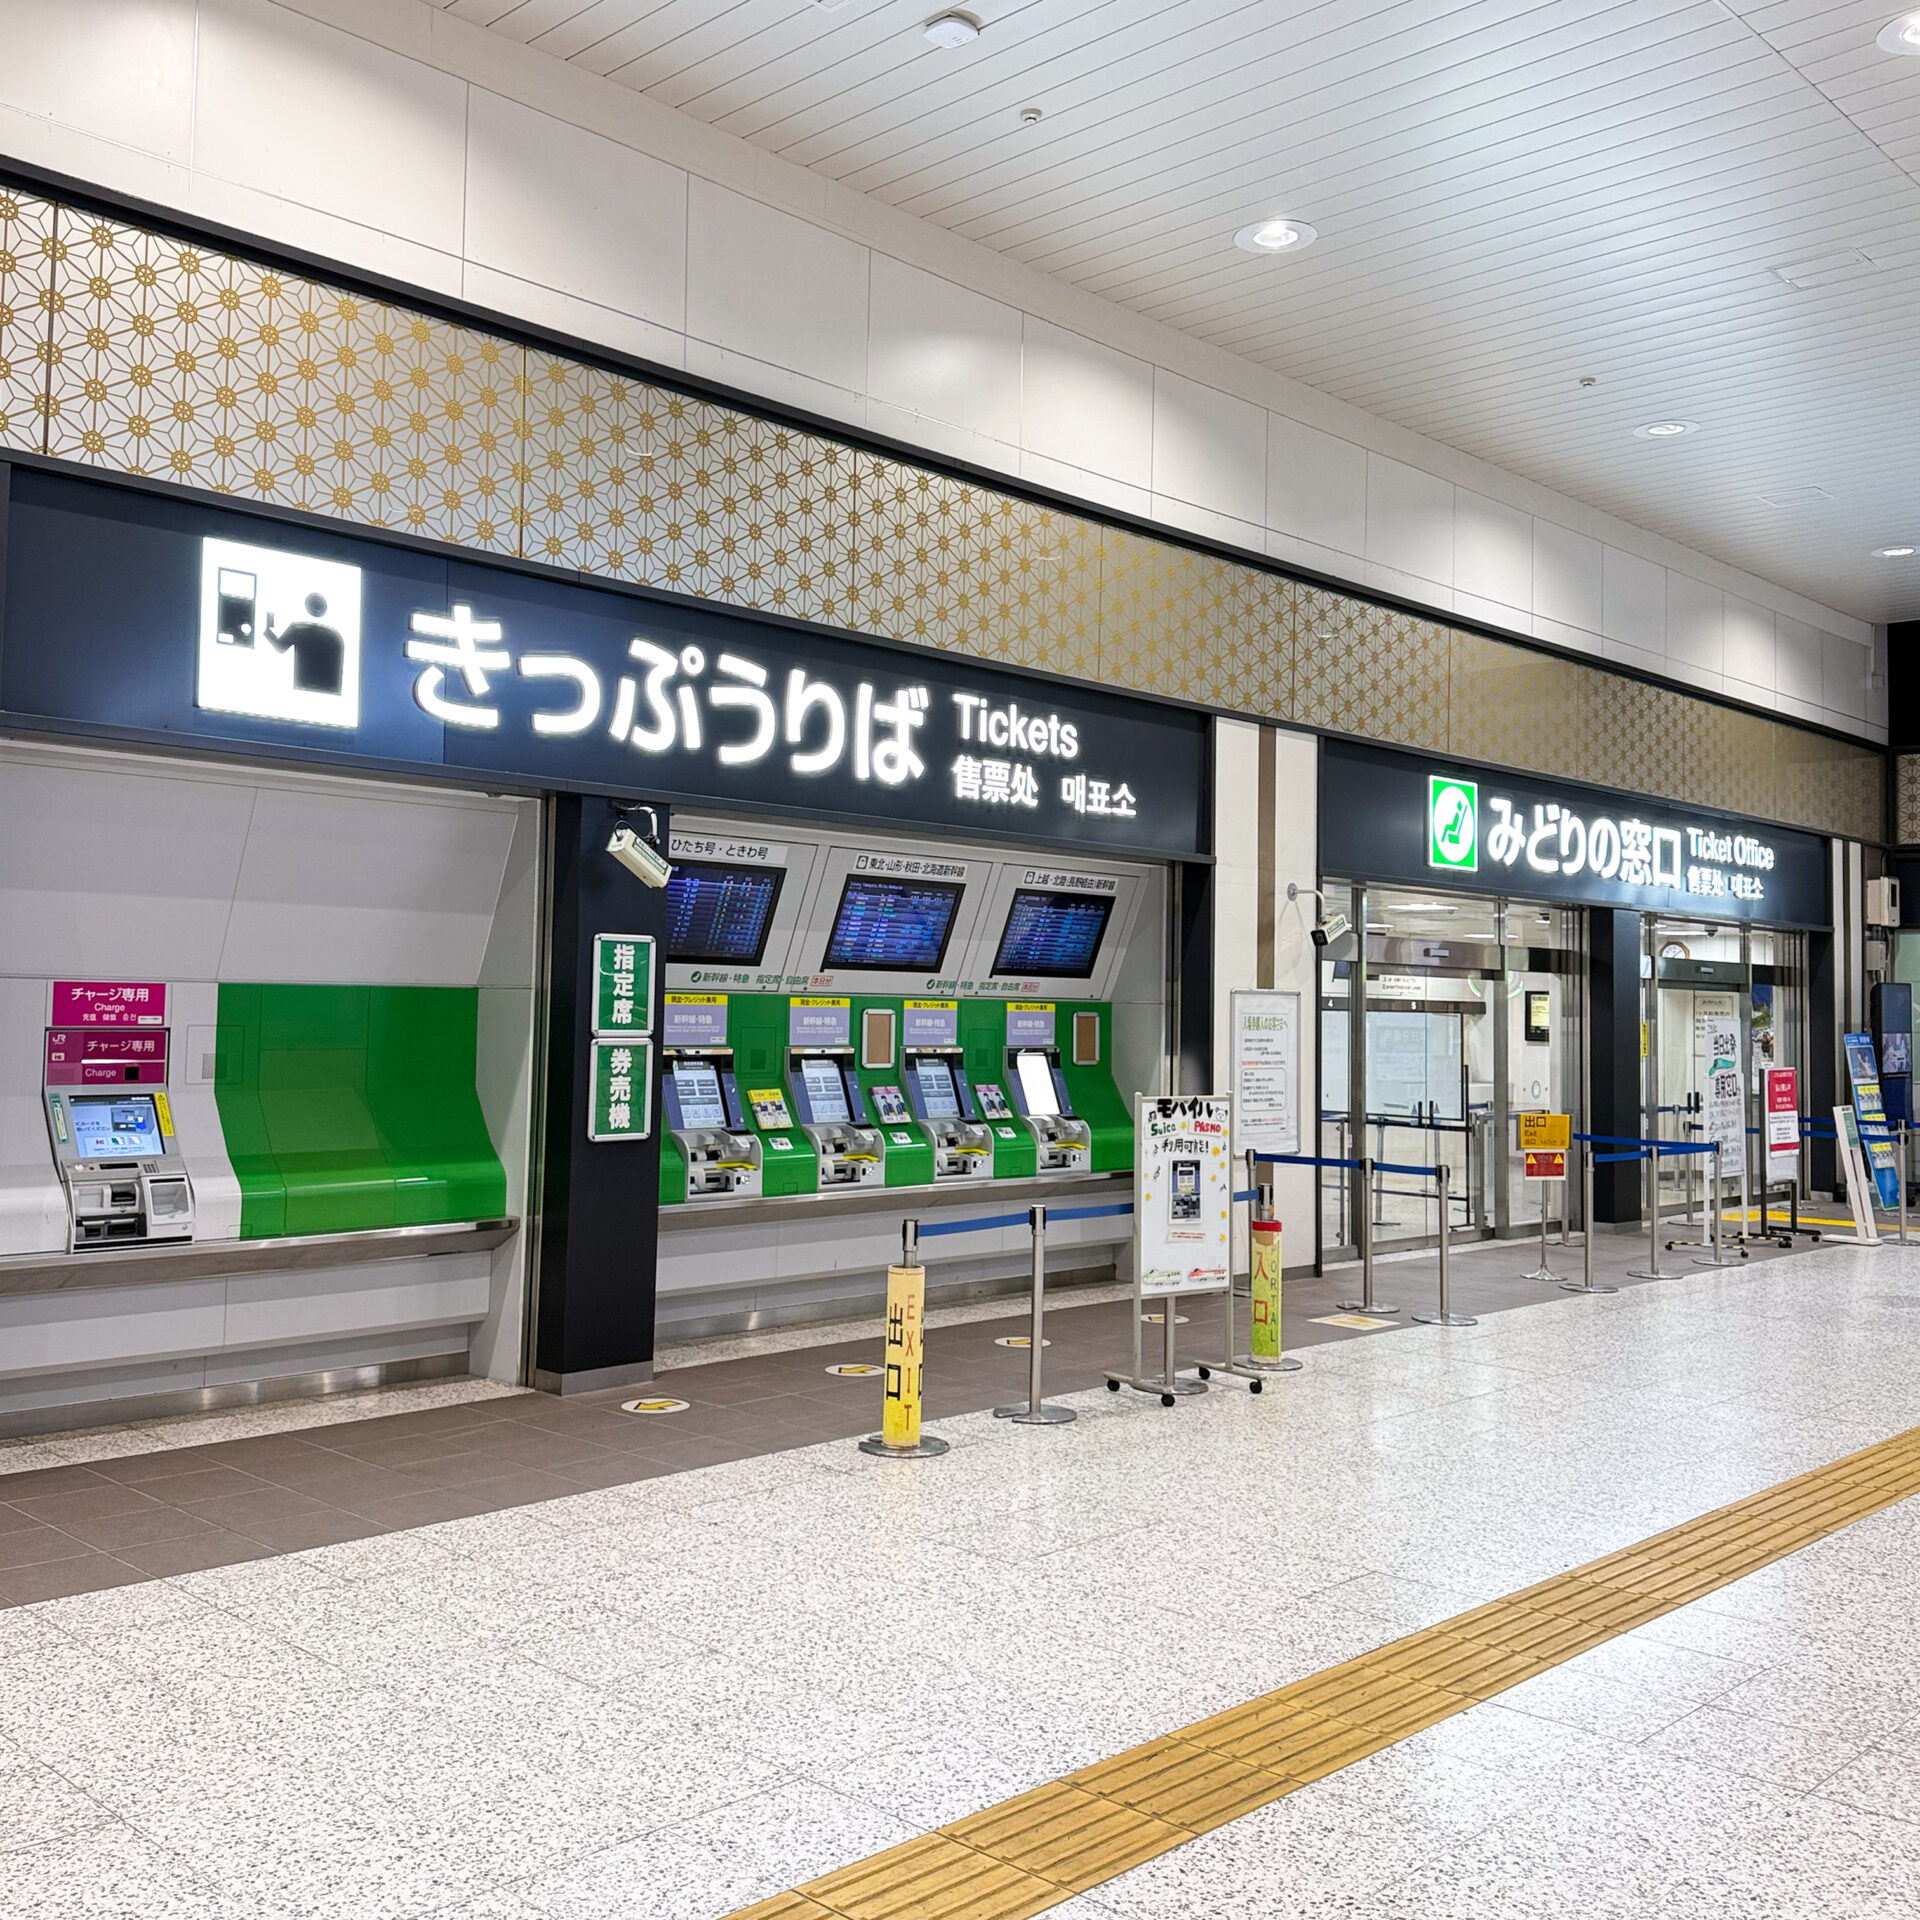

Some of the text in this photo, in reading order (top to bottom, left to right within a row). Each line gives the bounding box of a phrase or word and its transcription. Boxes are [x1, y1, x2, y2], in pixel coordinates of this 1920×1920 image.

[404, 604, 929, 785] きっぷうりば
[952, 693, 1078, 758] Tickets
[952, 754, 1137, 816] 售票处 매표소
[671, 838, 768, 860] ひたち号・ときわ号
[1487, 797, 1681, 889] みどりの窓口
[1686, 827, 1775, 870] Ticket Office
[1686, 865, 1764, 900] 售票处 매표소
[71, 987, 149, 1002] チャージ専用
[611, 944, 635, 1024] 指定席
[94, 1003, 126, 1012] Charge
[1328, 999, 1333, 1007] 4
[52, 1034, 66, 1043] JR
[87, 1040, 155, 1053] チャージ専用
[85, 1068, 117, 1078] Charge
[608, 1048, 633, 1130] 券売機
[1157, 1096, 1213, 1119] モバイル
[1525, 1116, 1546, 1127] 出口
[1151, 1122, 1176, 1136] Suica
[1253, 1251, 1269, 1325] 入口
[886, 1303, 903, 1402] 出口
[904, 1294, 916, 1431] EXIT
